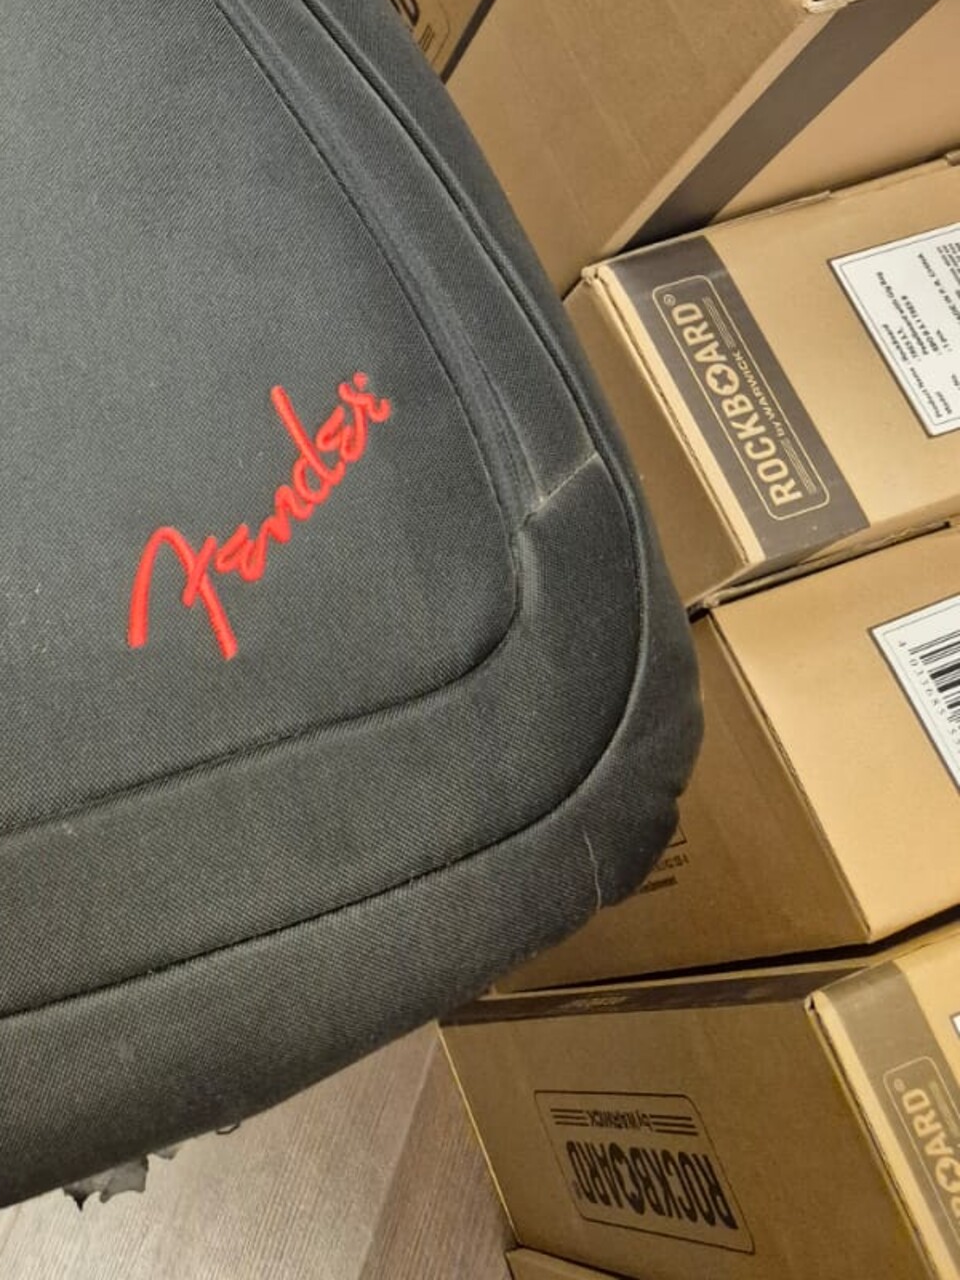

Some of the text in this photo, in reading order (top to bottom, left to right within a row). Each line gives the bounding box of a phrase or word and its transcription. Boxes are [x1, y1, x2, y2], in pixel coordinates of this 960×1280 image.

[671, 302, 803, 507] ROCKBOARD
[732, 350, 777, 421] WARWICK
[127, 372, 391, 661] Fender
